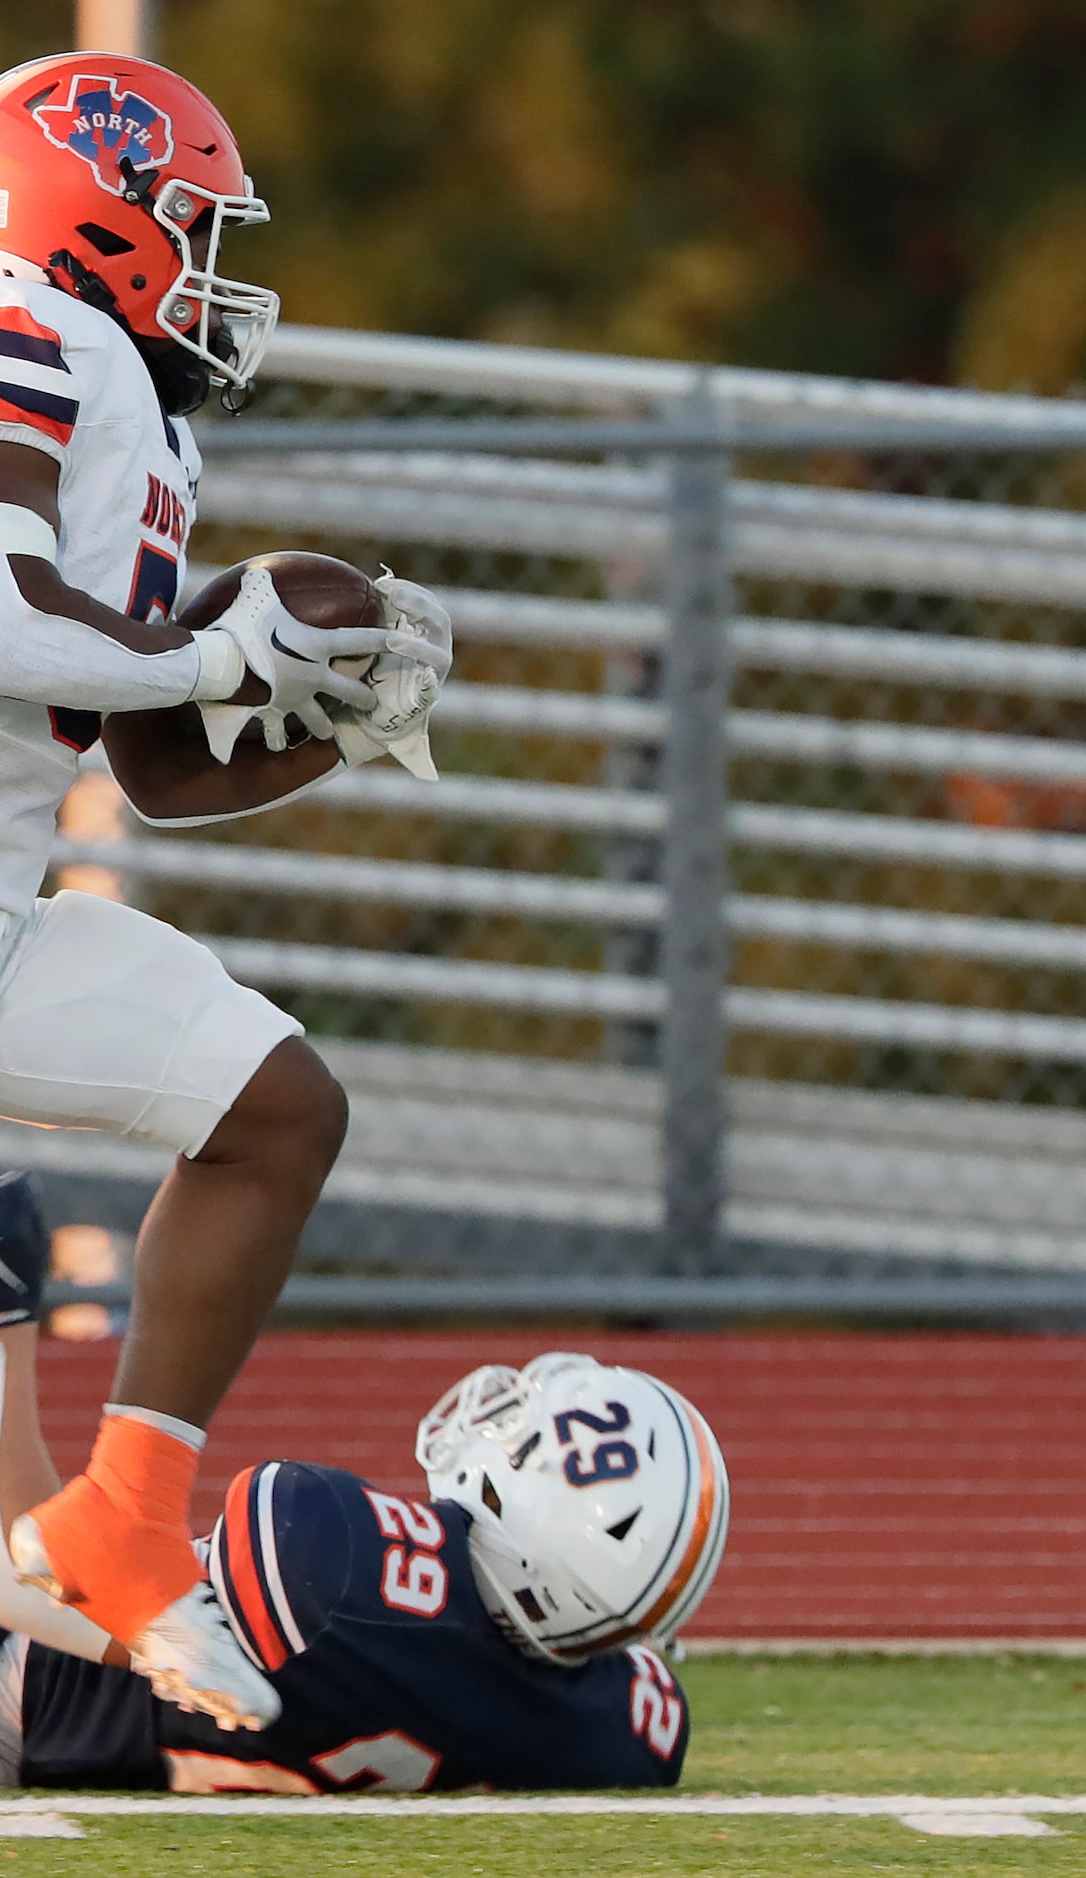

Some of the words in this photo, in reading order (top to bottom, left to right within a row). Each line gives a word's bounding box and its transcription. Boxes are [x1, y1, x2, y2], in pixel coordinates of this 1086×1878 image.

[72, 112, 153, 146] NORTH
[552, 1399, 640, 1489] 29
[361, 1486, 449, 1619] 29
